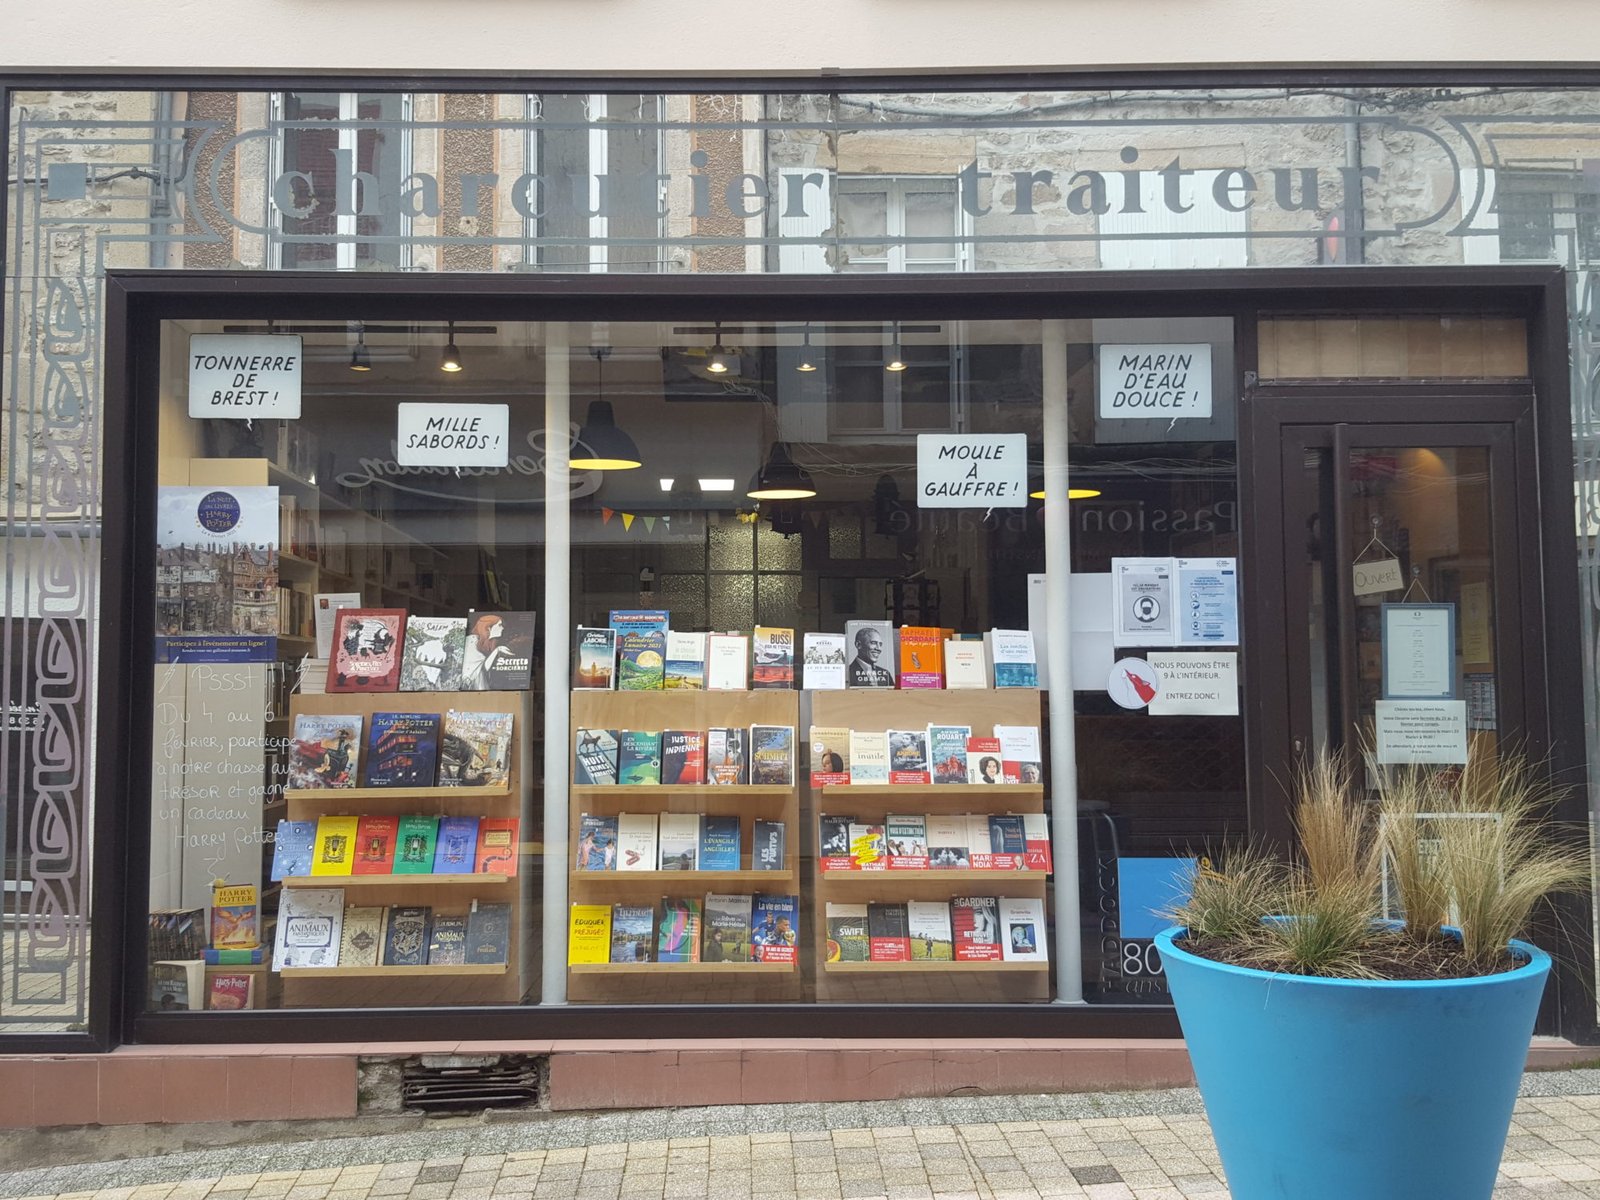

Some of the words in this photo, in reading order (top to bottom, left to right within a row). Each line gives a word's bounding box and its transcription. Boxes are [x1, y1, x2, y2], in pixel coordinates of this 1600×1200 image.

[274, 148, 826, 219] charcutier
[962, 145, 1385, 217] traiteur
[194, 355, 297, 371] TONNERRE
[1118, 354, 1193, 371] MARIN
[232, 373, 258, 388] DE
[1123, 372, 1188, 389] D'EAU
[210, 390, 269, 406] BREST
[272, 391, 279, 406] !
[1112, 391, 1186, 408] DOUCE
[1191, 391, 1199, 407] !
[425, 417, 482, 432] MILLE
[406, 434, 490, 450] SABORDS
[493, 435, 500, 450] !
[938, 445, 1006, 460] MOULE
[965, 462, 978, 480] À
[924, 482, 1009, 498] GAUFFRE
[1011, 481, 1019, 497] !
[1213, 660, 1230, 669] ÊTRE
[1169, 670, 1176, 679] À
[1166, 692, 1193, 700] ENTREZ
[1194, 692, 1216, 700] DONC
[156, 702, 191, 726] Du
[227, 711, 253, 723] au
[671, 735, 701, 744] JUSTICE
[665, 744, 700, 755] INDIENNE
[188, 806, 249, 821] cadeau
[219, 889, 253, 898] HARRY
[219, 895, 254, 903] POTTER
[959, 897, 996, 907] GARDNER
[289, 924, 329, 932] ANIMAUX
[839, 927, 865, 936] SWIFT
[1123, 942, 1164, 975] 80
